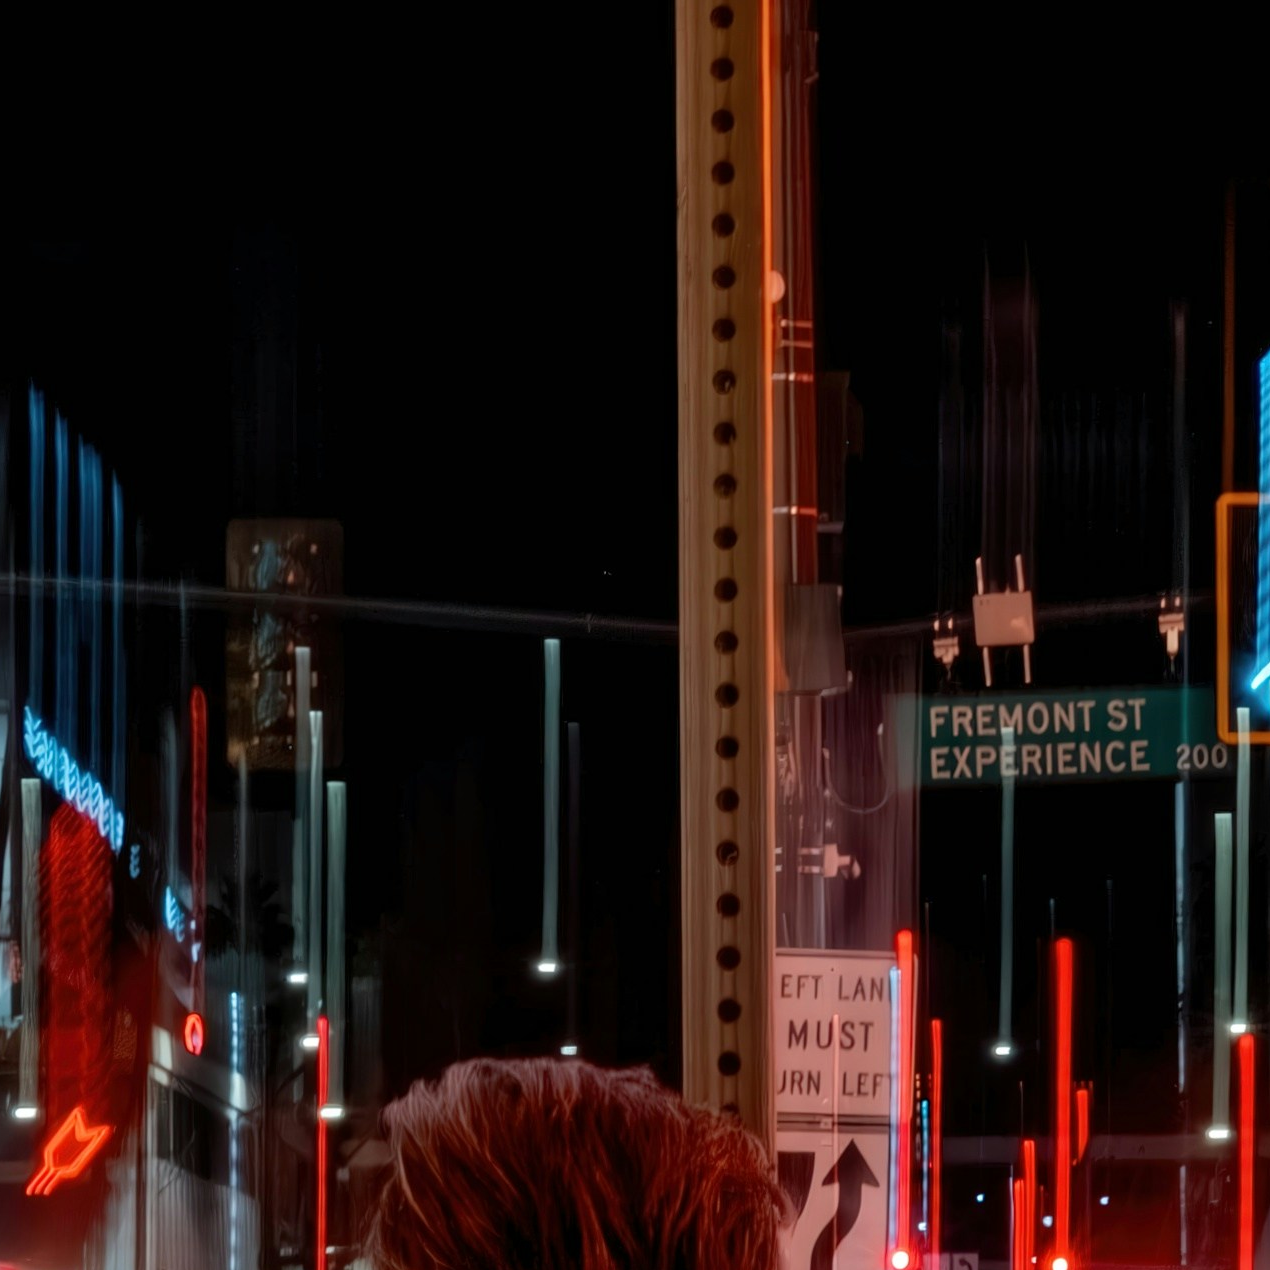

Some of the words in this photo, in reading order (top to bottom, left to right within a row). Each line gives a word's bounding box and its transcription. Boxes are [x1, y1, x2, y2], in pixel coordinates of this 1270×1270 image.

[930, 701, 1096, 738] FREMONT
[1107, 698, 1146, 731] ST
[930, 740, 1150, 779] EXPERIENCE
[1176, 744, 1228, 769] 200
[788, 1018, 874, 1052] MUST
